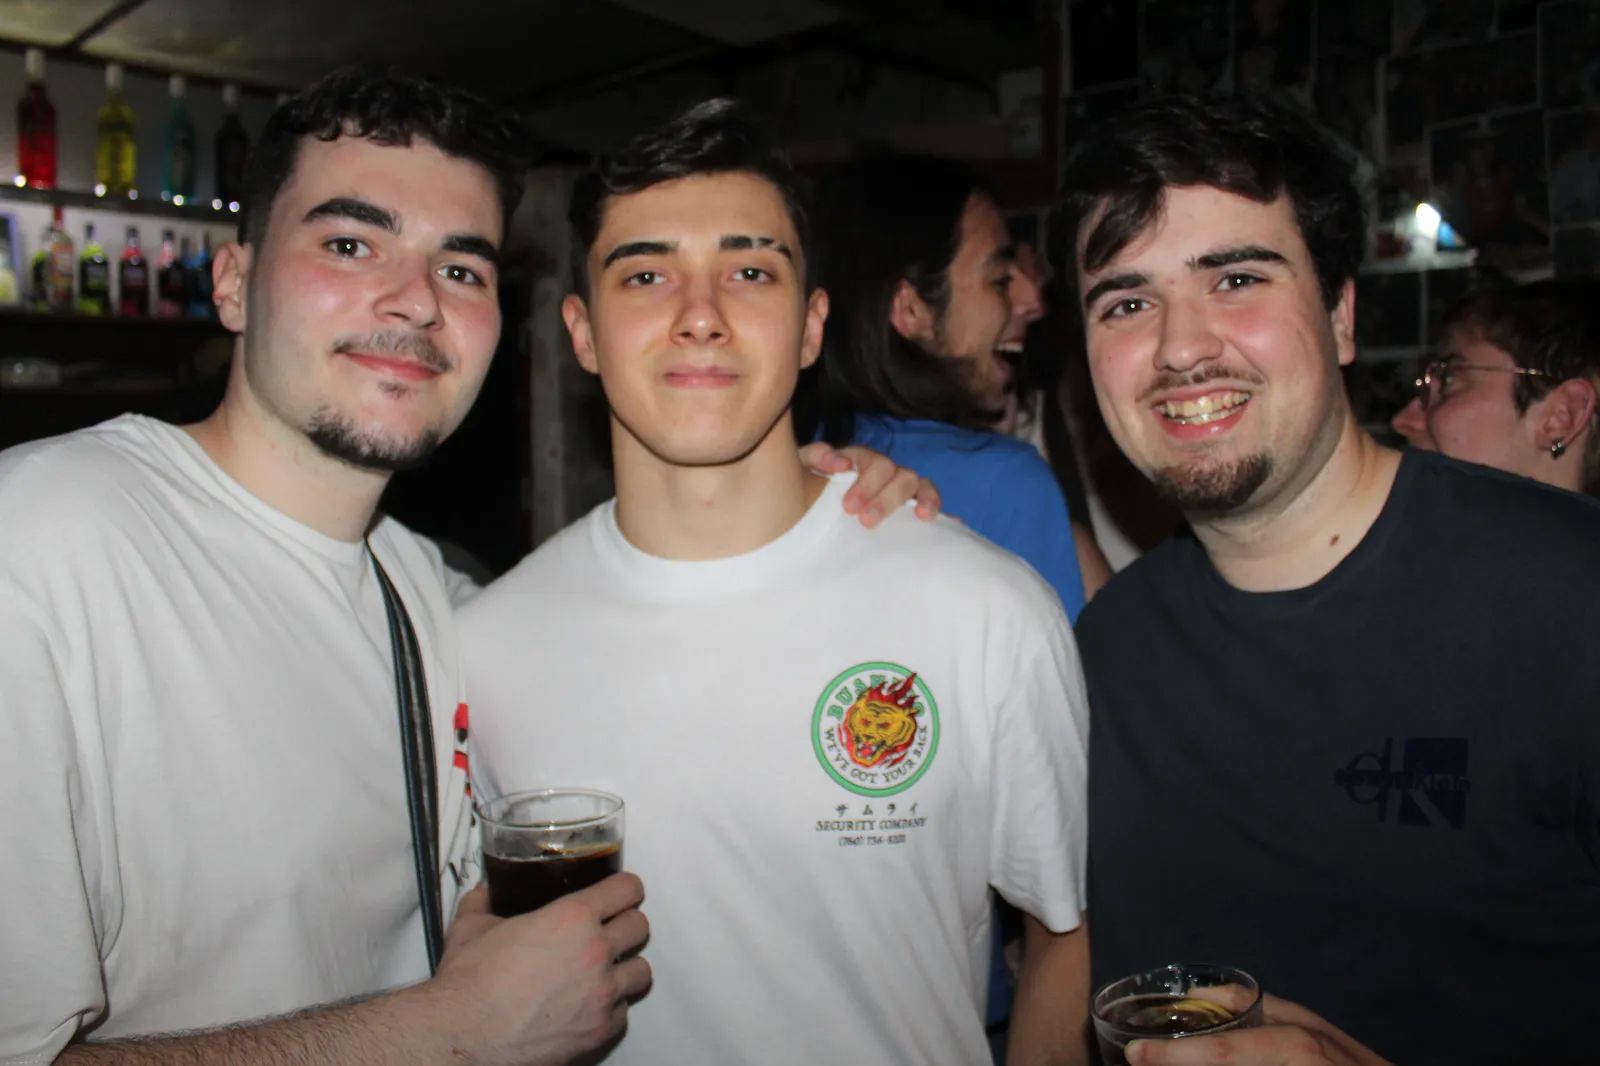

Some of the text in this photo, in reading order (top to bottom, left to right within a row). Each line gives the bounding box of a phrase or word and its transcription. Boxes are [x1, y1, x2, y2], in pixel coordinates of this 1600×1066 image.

[851, 768, 878, 784] GOT
[882, 760, 916, 783] YOUR
[913, 725, 928, 757] BACK
[815, 816, 927, 832] SECURITY COMPANY
